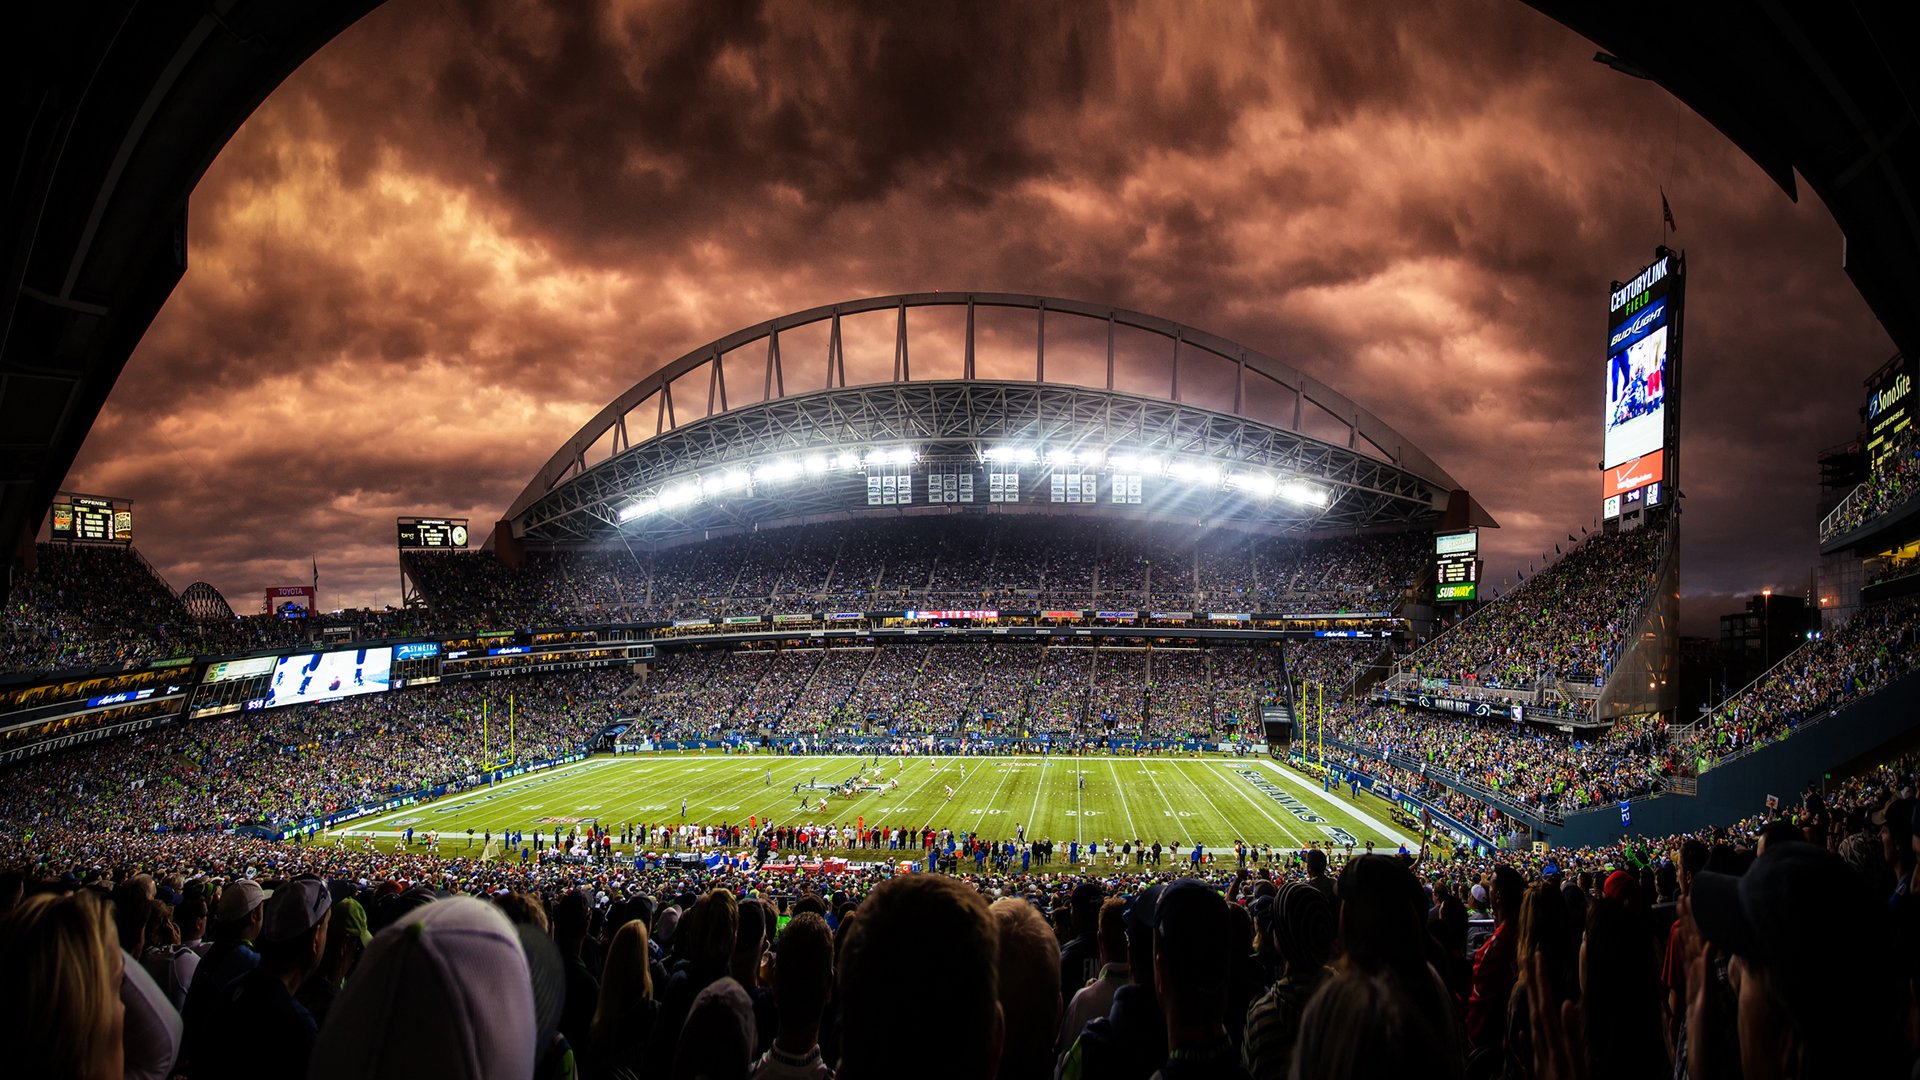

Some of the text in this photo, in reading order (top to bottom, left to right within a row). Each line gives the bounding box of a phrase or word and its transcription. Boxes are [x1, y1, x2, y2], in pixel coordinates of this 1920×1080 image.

[1626, 290, 1650, 316] FIELD
[1610, 306, 1664, 346] BUD LIGHT
[1878, 373, 1911, 414] SonoSite
[1872, 408, 1905, 434] DEFENSE
[1437, 585, 1474, 598] SUBWAY
[410, 644, 437, 653] SYMETRA
[490, 668, 516, 677] HOME
[1435, 699, 1470, 712] HAWKS NEST
[9, 751, 23, 762] TO
[30, 729, 112, 756] CENTURYLINK
[118, 720, 153, 734] FIELD
[1234, 769, 1328, 824] SEAHAWKS
[1621, 806, 1630, 822] 12
